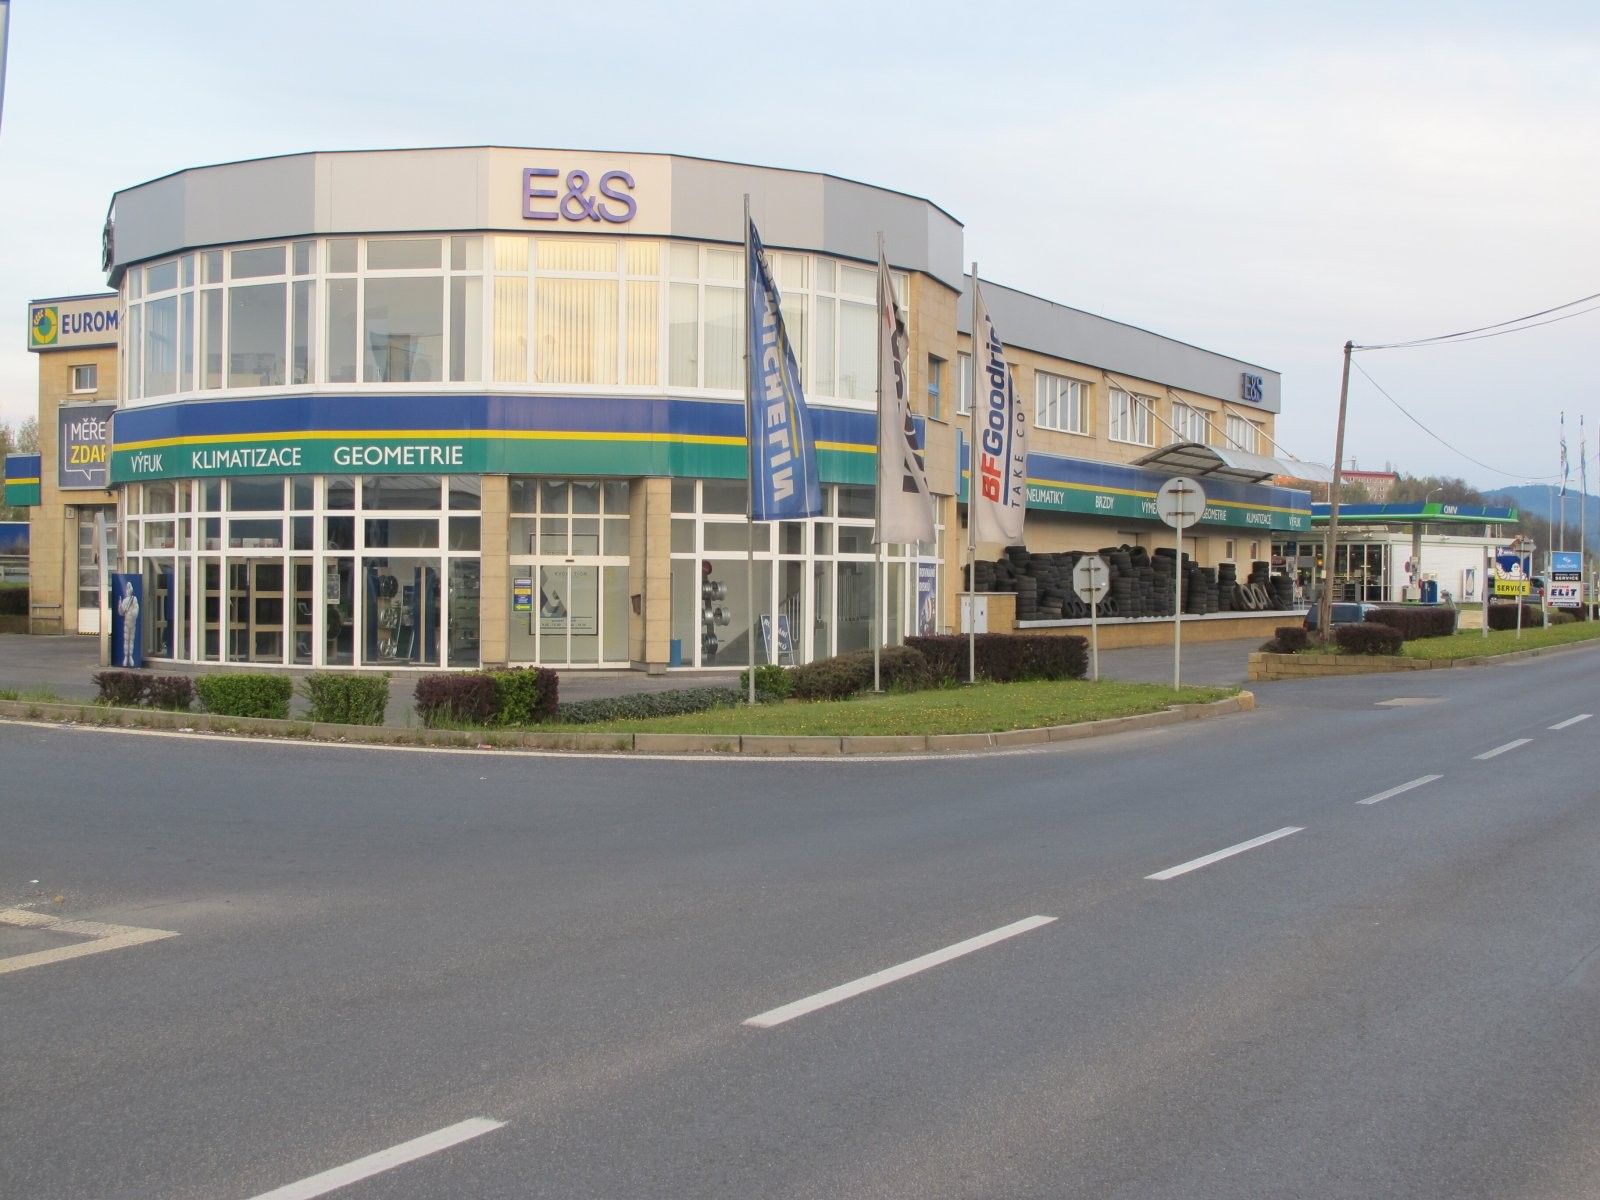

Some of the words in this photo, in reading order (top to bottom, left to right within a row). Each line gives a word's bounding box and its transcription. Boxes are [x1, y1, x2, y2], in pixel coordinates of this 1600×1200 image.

[522, 167, 637, 224] E&S
[62, 309, 118, 334] EUROM
[1241, 372, 1263, 403] E&S
[71, 417, 106, 441] MĚŘE
[131, 452, 163, 473] VÝFUK
[192, 447, 302, 469] KLIMATIZACE
[333, 445, 464, 466] GEOMETRIE
[1011, 454, 1025, 509] TAKE
[1095, 495, 1115, 510] BRZDY
[1246, 512, 1272, 525] KLIMATIZACE
[1443, 504, 1458, 515] OMV
